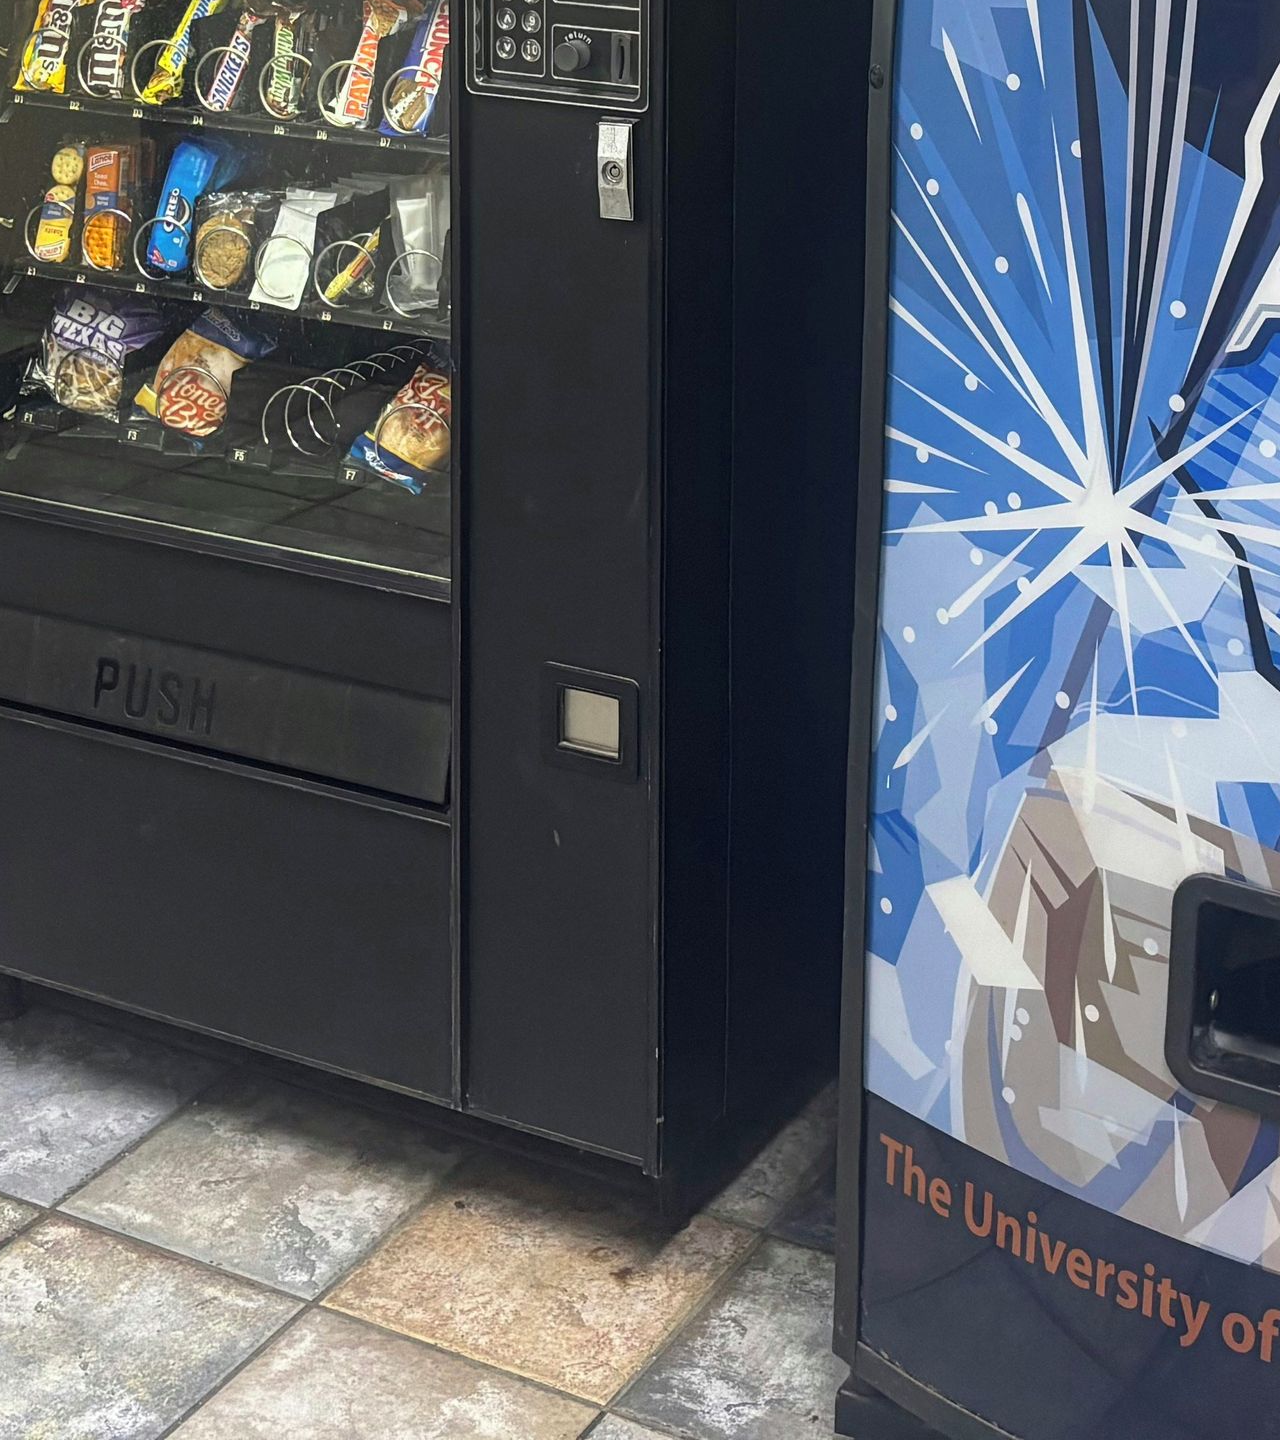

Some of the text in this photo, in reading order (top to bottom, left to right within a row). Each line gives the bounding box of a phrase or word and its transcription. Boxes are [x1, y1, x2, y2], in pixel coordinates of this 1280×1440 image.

[529, 16, 536, 27] 9
[564, 31, 592, 45] return
[525, 45, 538, 55] 10
[211, 35, 250, 111] SNICKERS
[14, 95, 23, 104] D1
[70, 101, 80, 110] D2
[133, 109, 143, 118] D3
[193, 116, 203, 125] D4
[274, 125, 285, 135] D5
[316, 130, 328, 140] D6
[380, 138, 391, 147] D7
[163, 187, 181, 233] OREO
[67, 298, 126, 340] BIG
[52, 314, 126, 361] TEXAS
[162, 371, 227, 421] Honey
[24, 412, 33, 423] F1
[127, 430, 138, 441] F3
[234, 450, 245, 461] F5
[345, 471, 357, 481] F7
[94, 656, 217, 735] PUSH
[880, 1132, 952, 1218] The
[963, 1180, 1211, 1348] University
